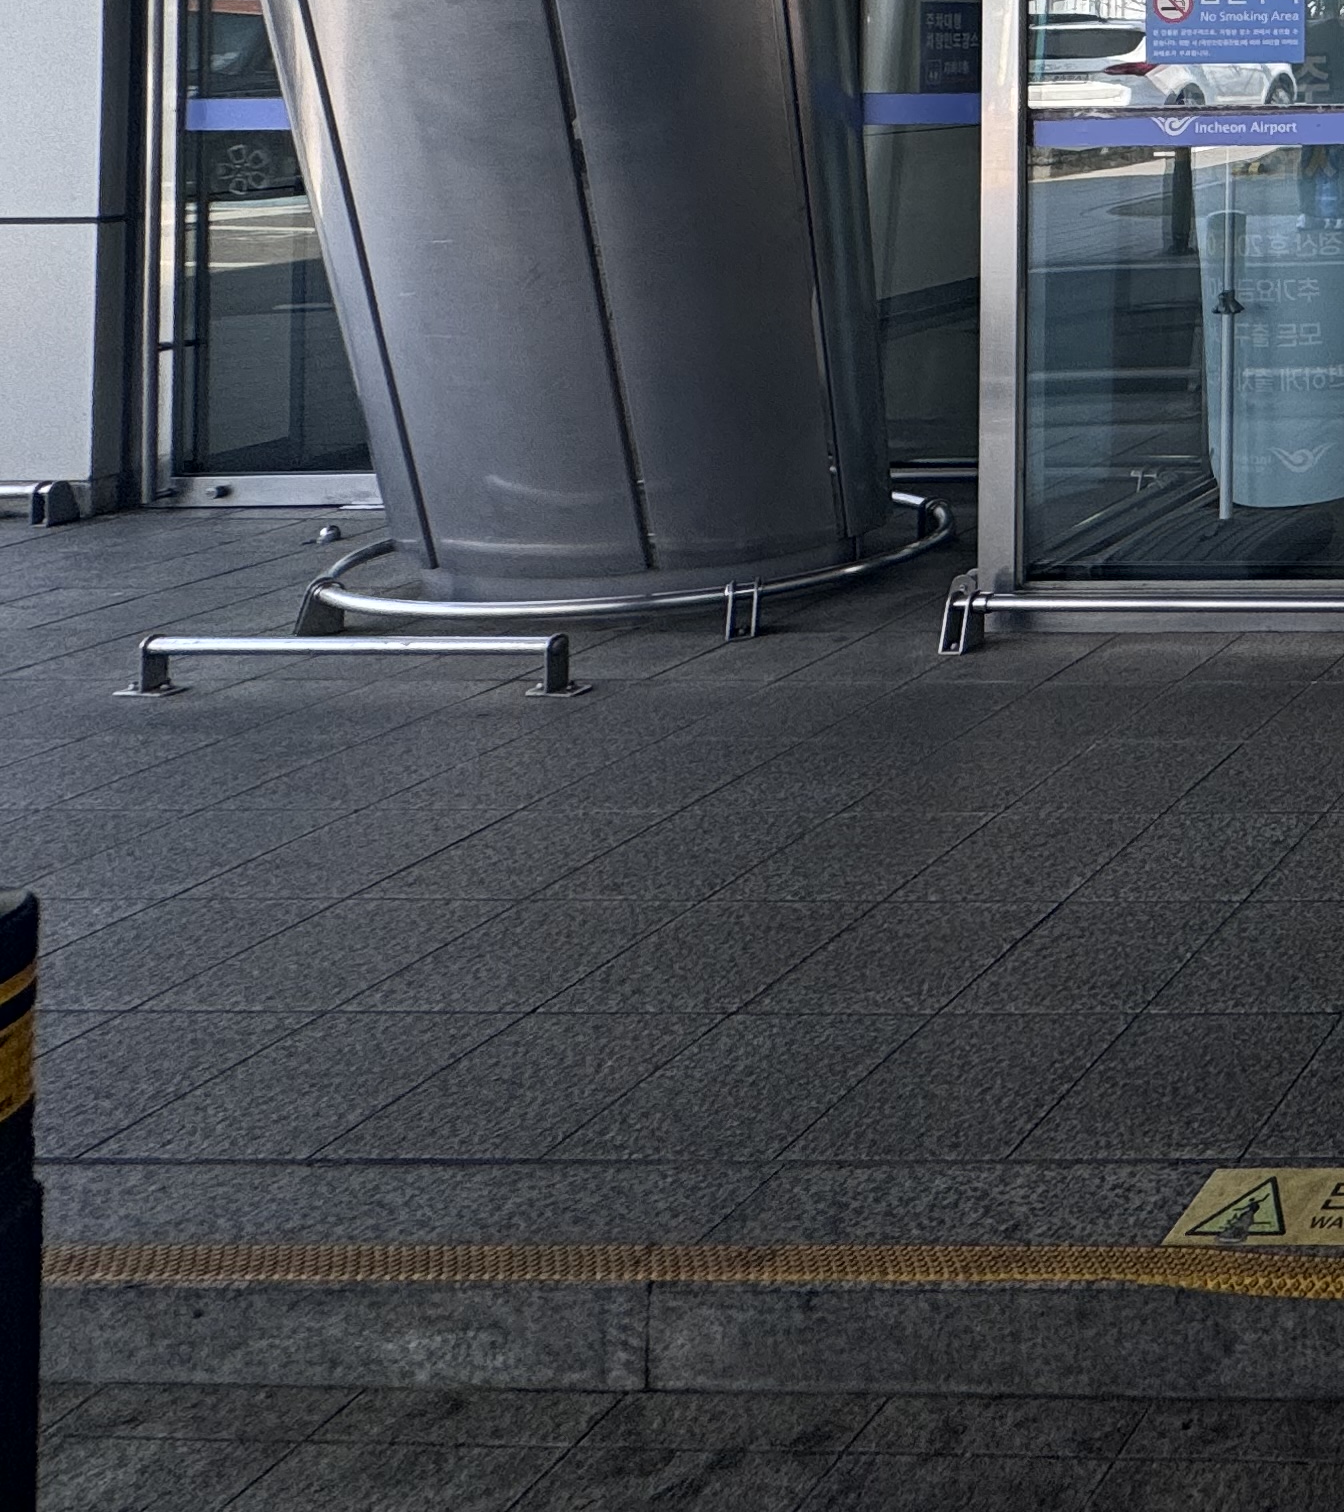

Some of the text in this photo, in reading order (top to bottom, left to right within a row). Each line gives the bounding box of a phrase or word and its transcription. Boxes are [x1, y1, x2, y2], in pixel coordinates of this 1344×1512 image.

[1200, 10, 1299, 24] No Smoking Area
[1194, 120, 1298, 136] Incheon Airport
